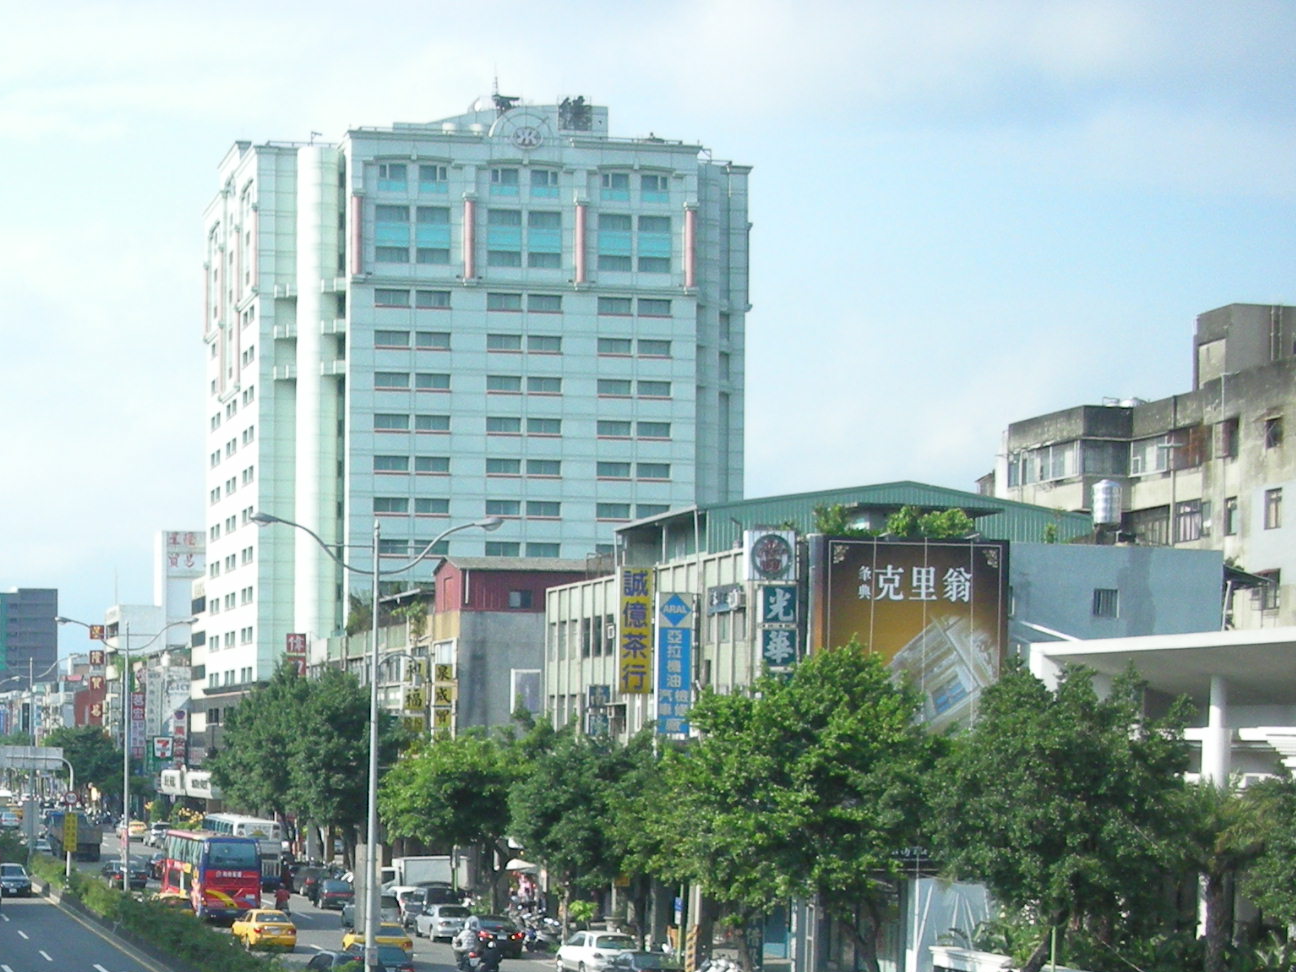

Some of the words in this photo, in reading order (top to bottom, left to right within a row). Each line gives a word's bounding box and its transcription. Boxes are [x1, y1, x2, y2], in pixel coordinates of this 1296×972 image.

[873, 564, 973, 603] 克里翁
[622, 569, 650, 691] 誠億茶行
[764, 588, 794, 665] 光華
